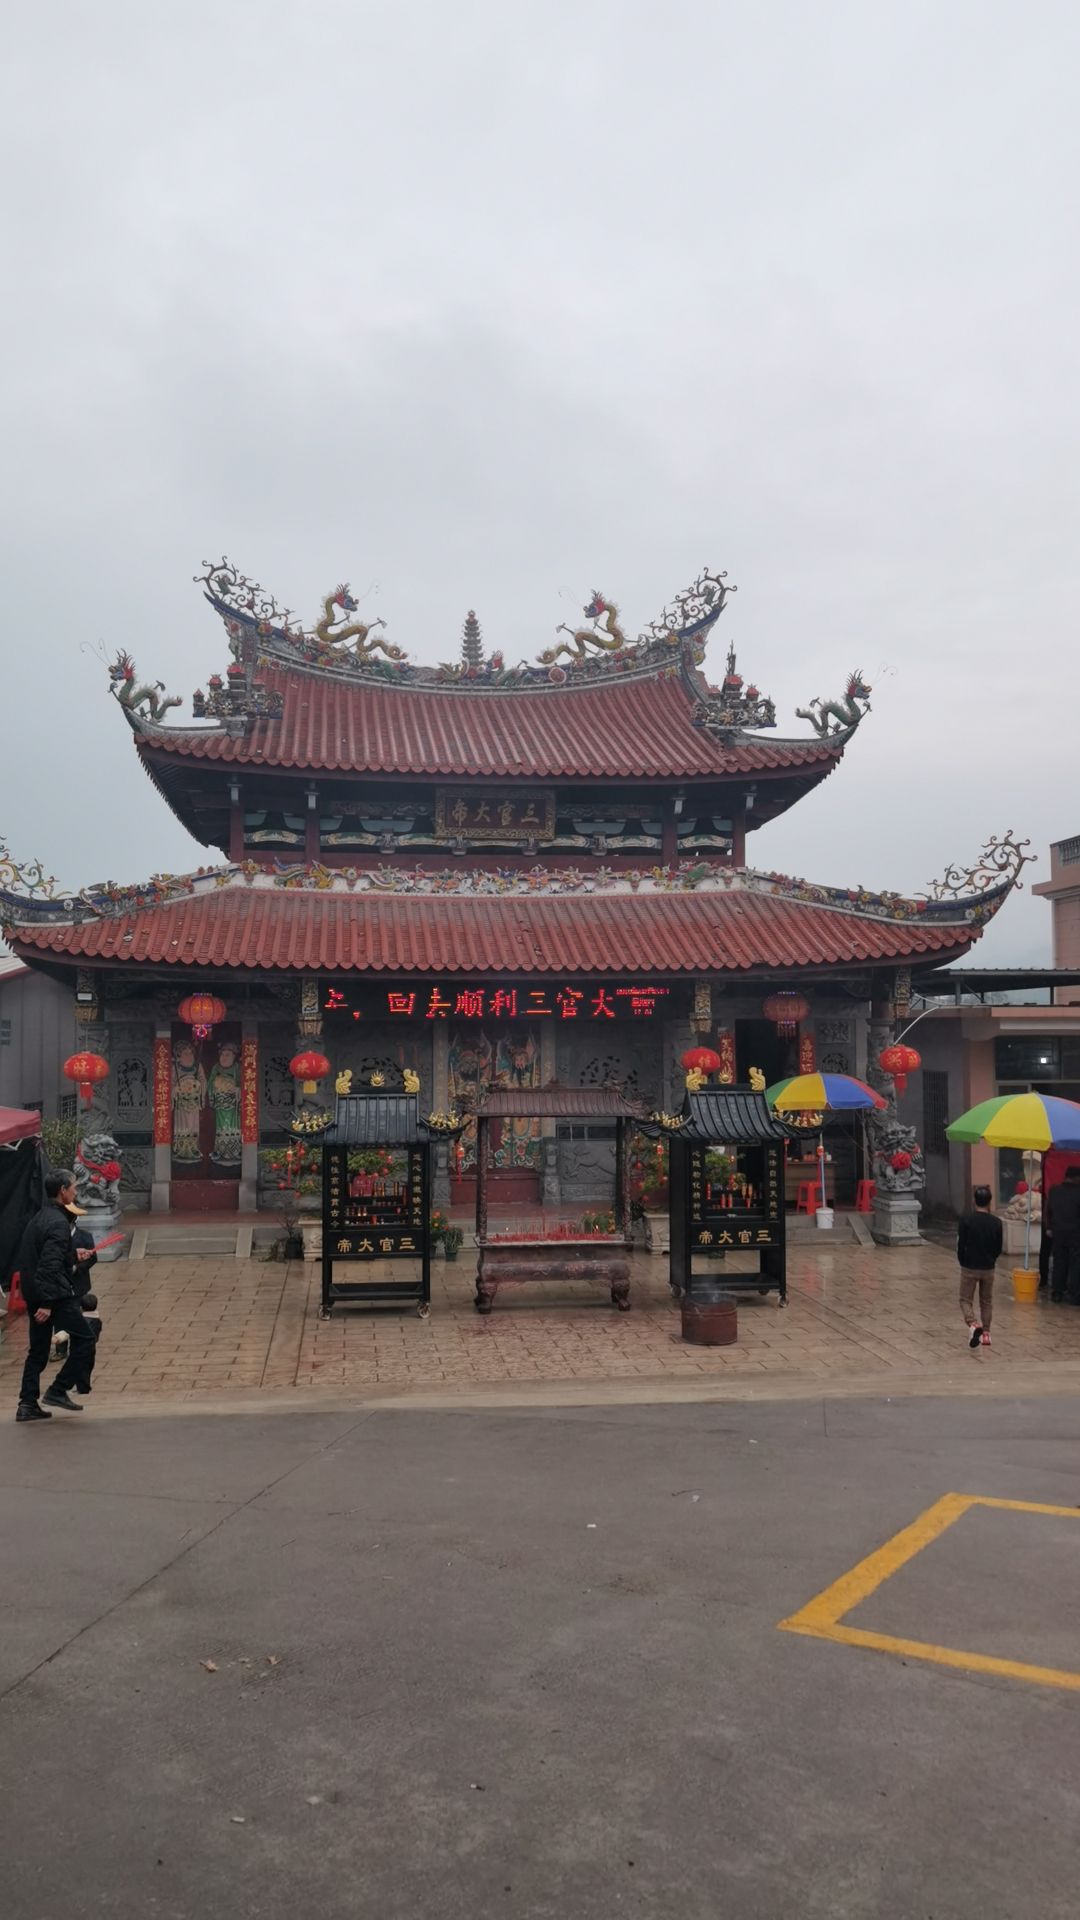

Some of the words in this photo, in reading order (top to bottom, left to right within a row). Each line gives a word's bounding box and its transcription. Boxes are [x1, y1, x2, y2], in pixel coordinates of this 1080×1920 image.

[451, 799, 540, 827] 三官大帝
[337, 1237, 416, 1253] 三官大帝
[698, 1229, 772, 1245] 三官大帝
